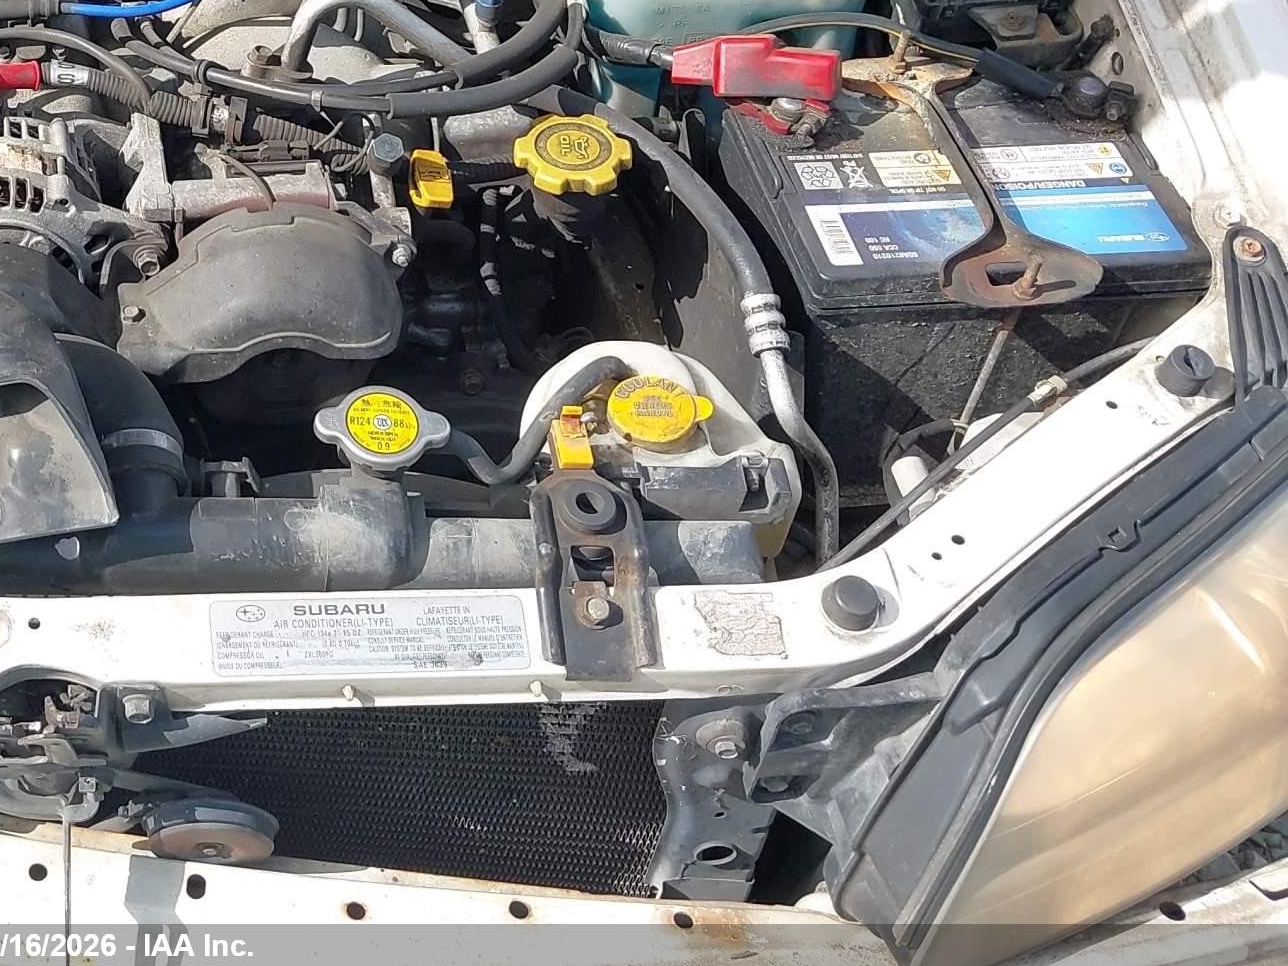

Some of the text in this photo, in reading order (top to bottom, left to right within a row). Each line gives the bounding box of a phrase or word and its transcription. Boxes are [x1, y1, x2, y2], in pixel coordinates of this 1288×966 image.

[560, 135, 570, 155] OIL
[1099, 233, 1146, 242] SUBARU
[293, 603, 385, 616] SUBARU
[423, 606, 461, 615] LAFAYETTE
[274, 620, 289, 629] AIR
